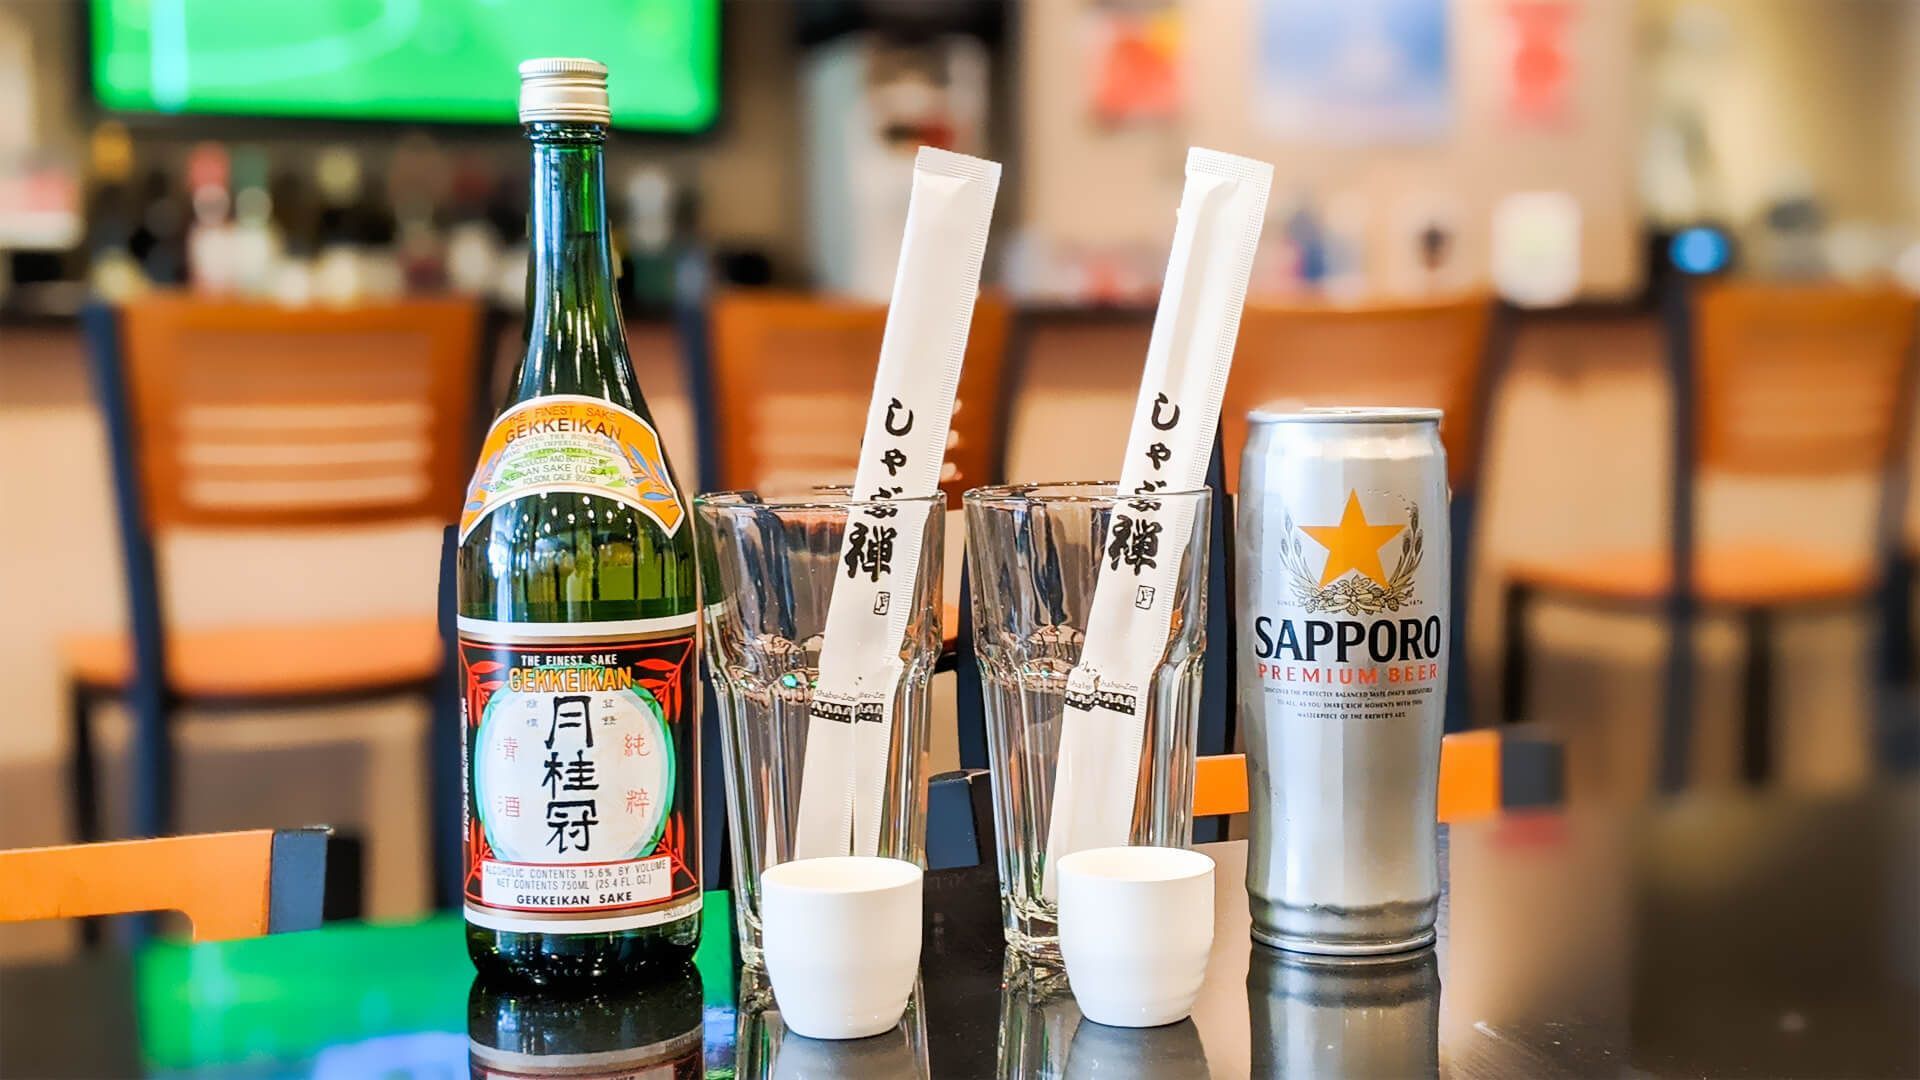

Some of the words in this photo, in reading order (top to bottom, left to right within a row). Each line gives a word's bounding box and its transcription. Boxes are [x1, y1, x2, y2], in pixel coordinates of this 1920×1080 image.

[535, 405, 575, 417] FINEST
[586, 407, 617, 421] SAKE
[505, 417, 622, 444] GEKKEIKAN
[543, 464, 572, 473] SAKE
[1255, 614, 1441, 663] SAPPORO
[521, 655, 541, 667] THE
[546, 655, 584, 666] FINEST
[591, 654, 618, 665] SAKE
[508, 666, 634, 693] GEKKEIKAN
[1257, 663, 1378, 685] PREMIUM
[1388, 663, 1439, 683] BEER
[542, 694, 600, 854] 月桂冠
[485, 864, 524, 877] ALCOHOLIC
[529, 867, 577, 880] CONTENTS
[584, 867, 612, 879] 15.6%
[618, 865, 630, 877] BY
[635, 859, 667, 872] VOLUME
[496, 876, 510, 888] NET
[513, 879, 559, 891] CONTENTS
[561, 879, 590, 890] 750ML
[516, 894, 590, 906] GEKKEIKAN
[599, 891, 633, 904] SAKE
